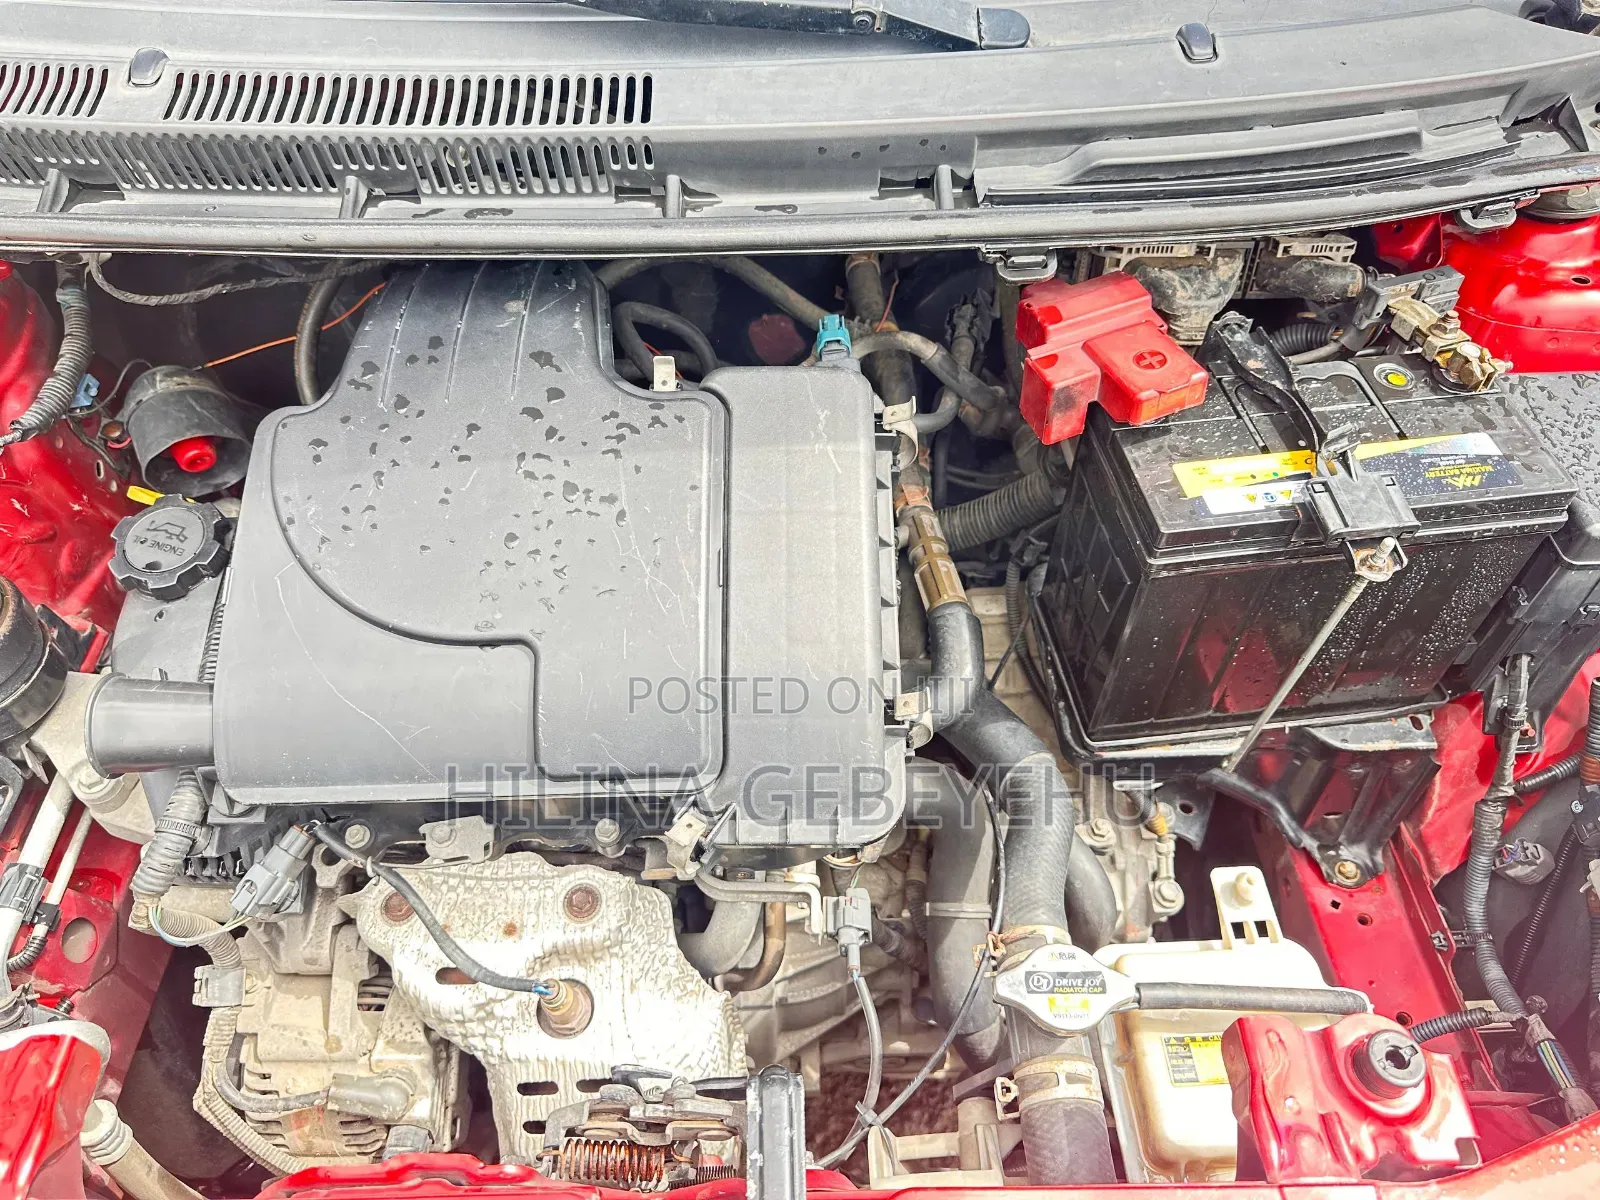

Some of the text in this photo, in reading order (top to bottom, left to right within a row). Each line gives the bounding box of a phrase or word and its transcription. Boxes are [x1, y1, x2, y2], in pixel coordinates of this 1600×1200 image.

[1425, 468, 1459, 478] BATTERY
[132, 535, 185, 556] ENGINE OIL
[1055, 978, 1083, 986] DRIVE
[1083, 978, 1101, 988] JOY
